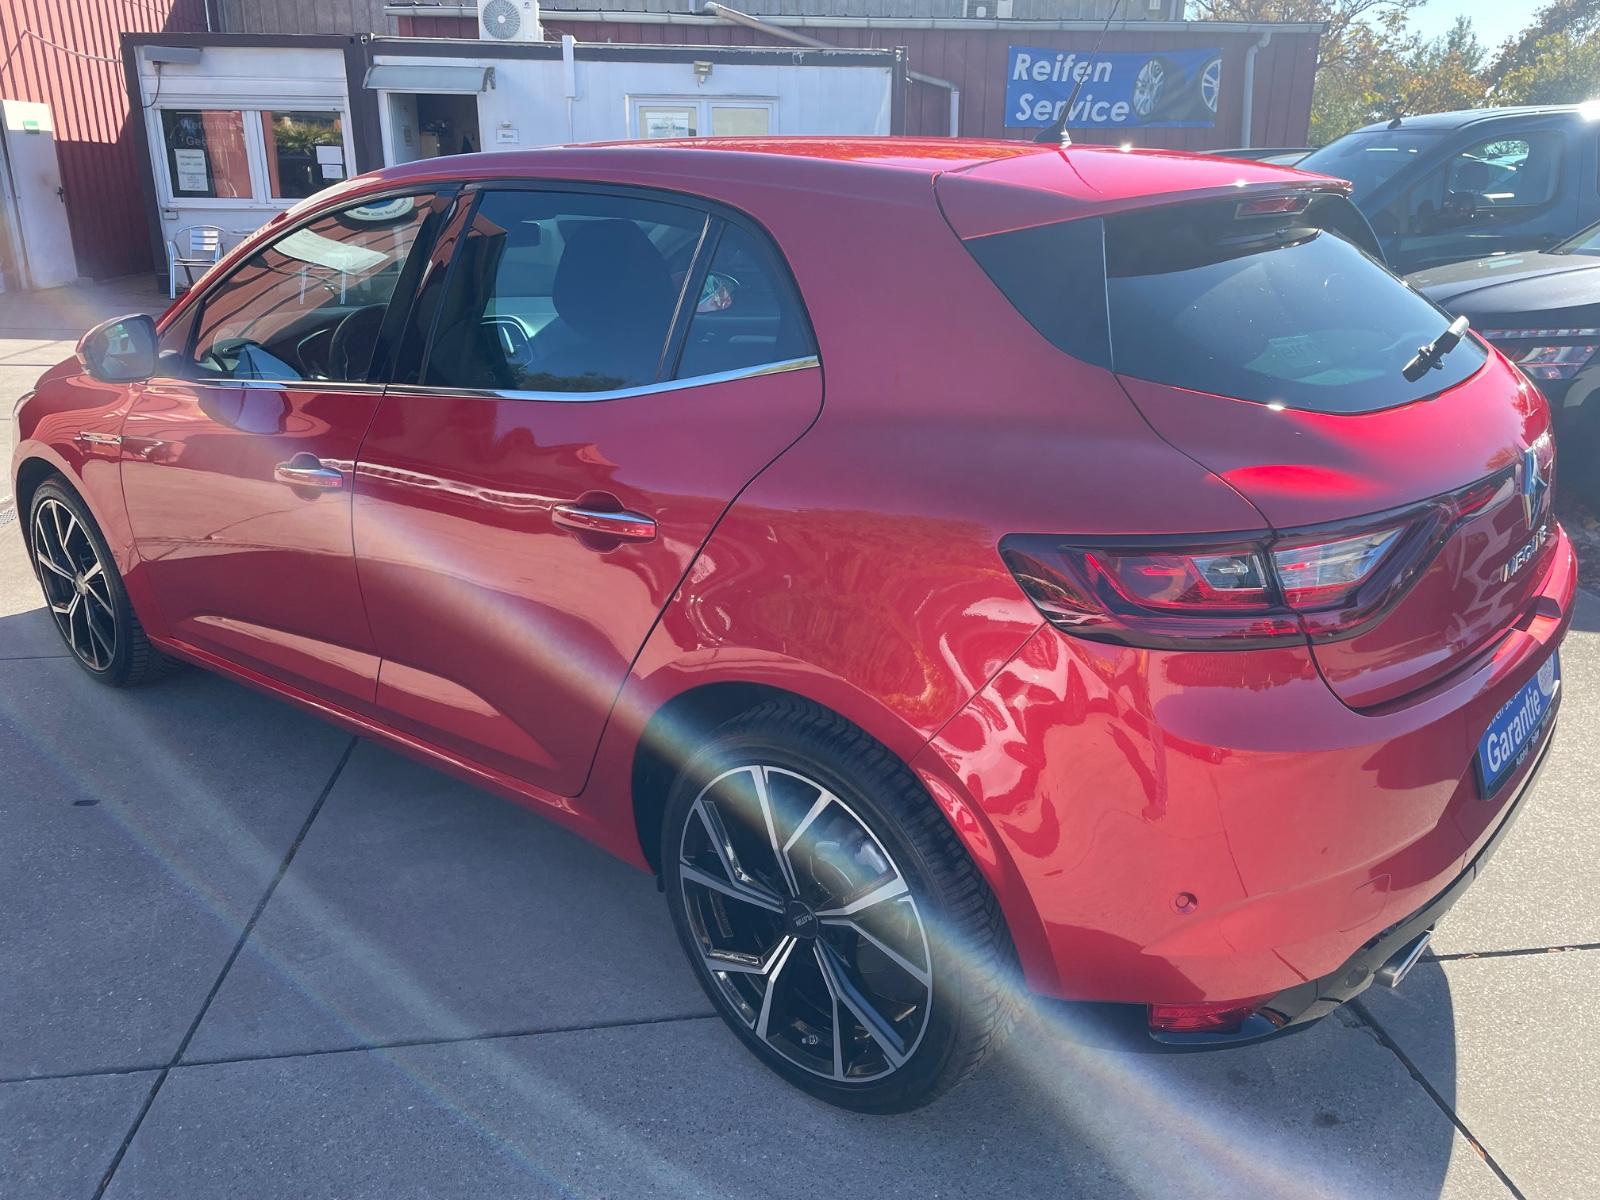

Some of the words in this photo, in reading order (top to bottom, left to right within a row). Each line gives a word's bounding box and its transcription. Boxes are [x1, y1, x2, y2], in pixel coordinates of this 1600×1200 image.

[1013, 53, 1112, 82] Reifen
[1016, 93, 1130, 121] Service
[1487, 687, 1541, 773] Garantie
